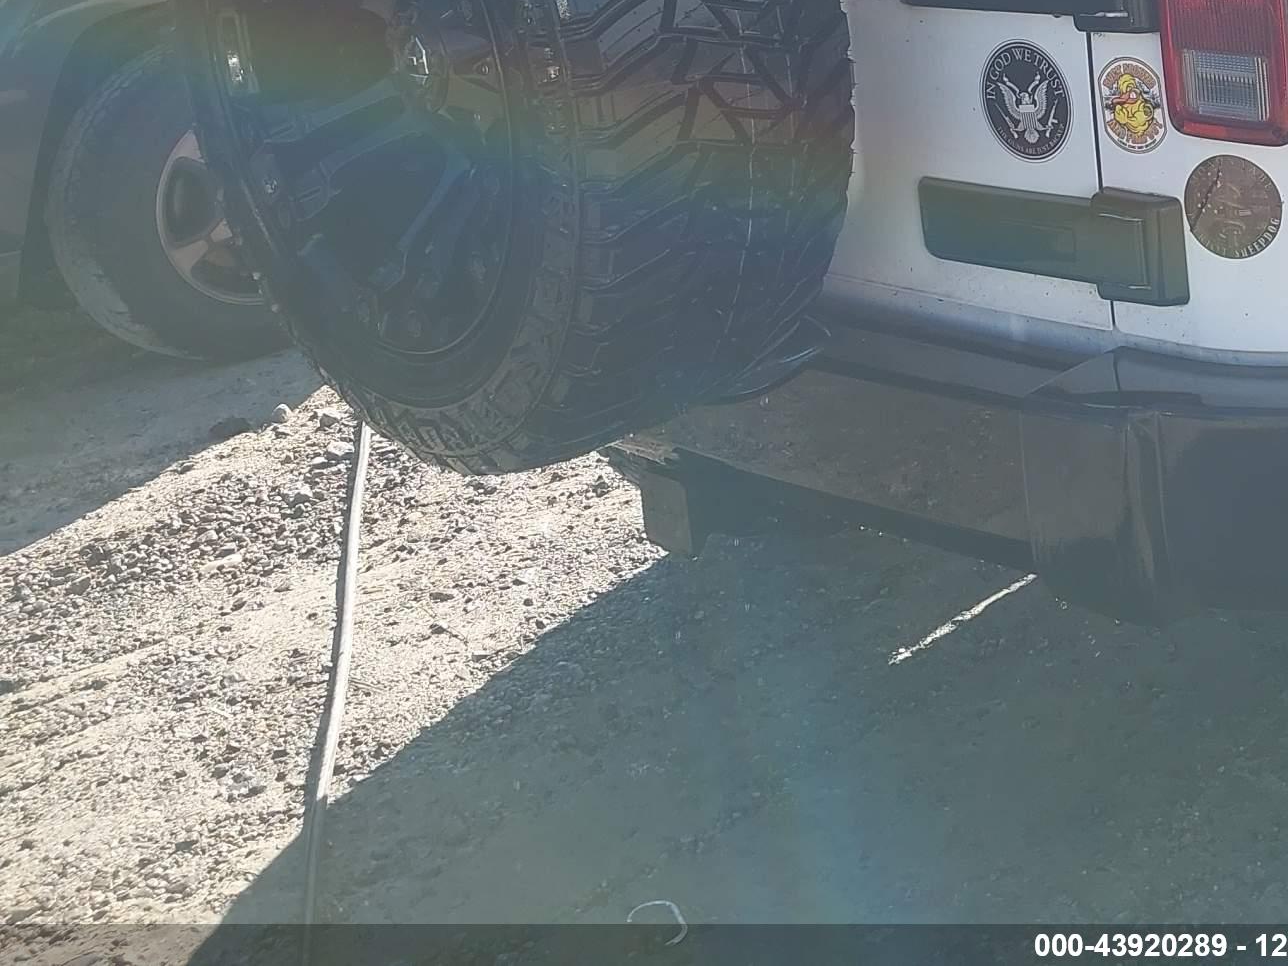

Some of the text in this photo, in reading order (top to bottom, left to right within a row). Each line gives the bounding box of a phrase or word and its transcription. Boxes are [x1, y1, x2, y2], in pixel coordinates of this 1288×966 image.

[986, 47, 1066, 100] IN GOD WE TRUST
[1234, 217, 1281, 258] SHEEPDOG
